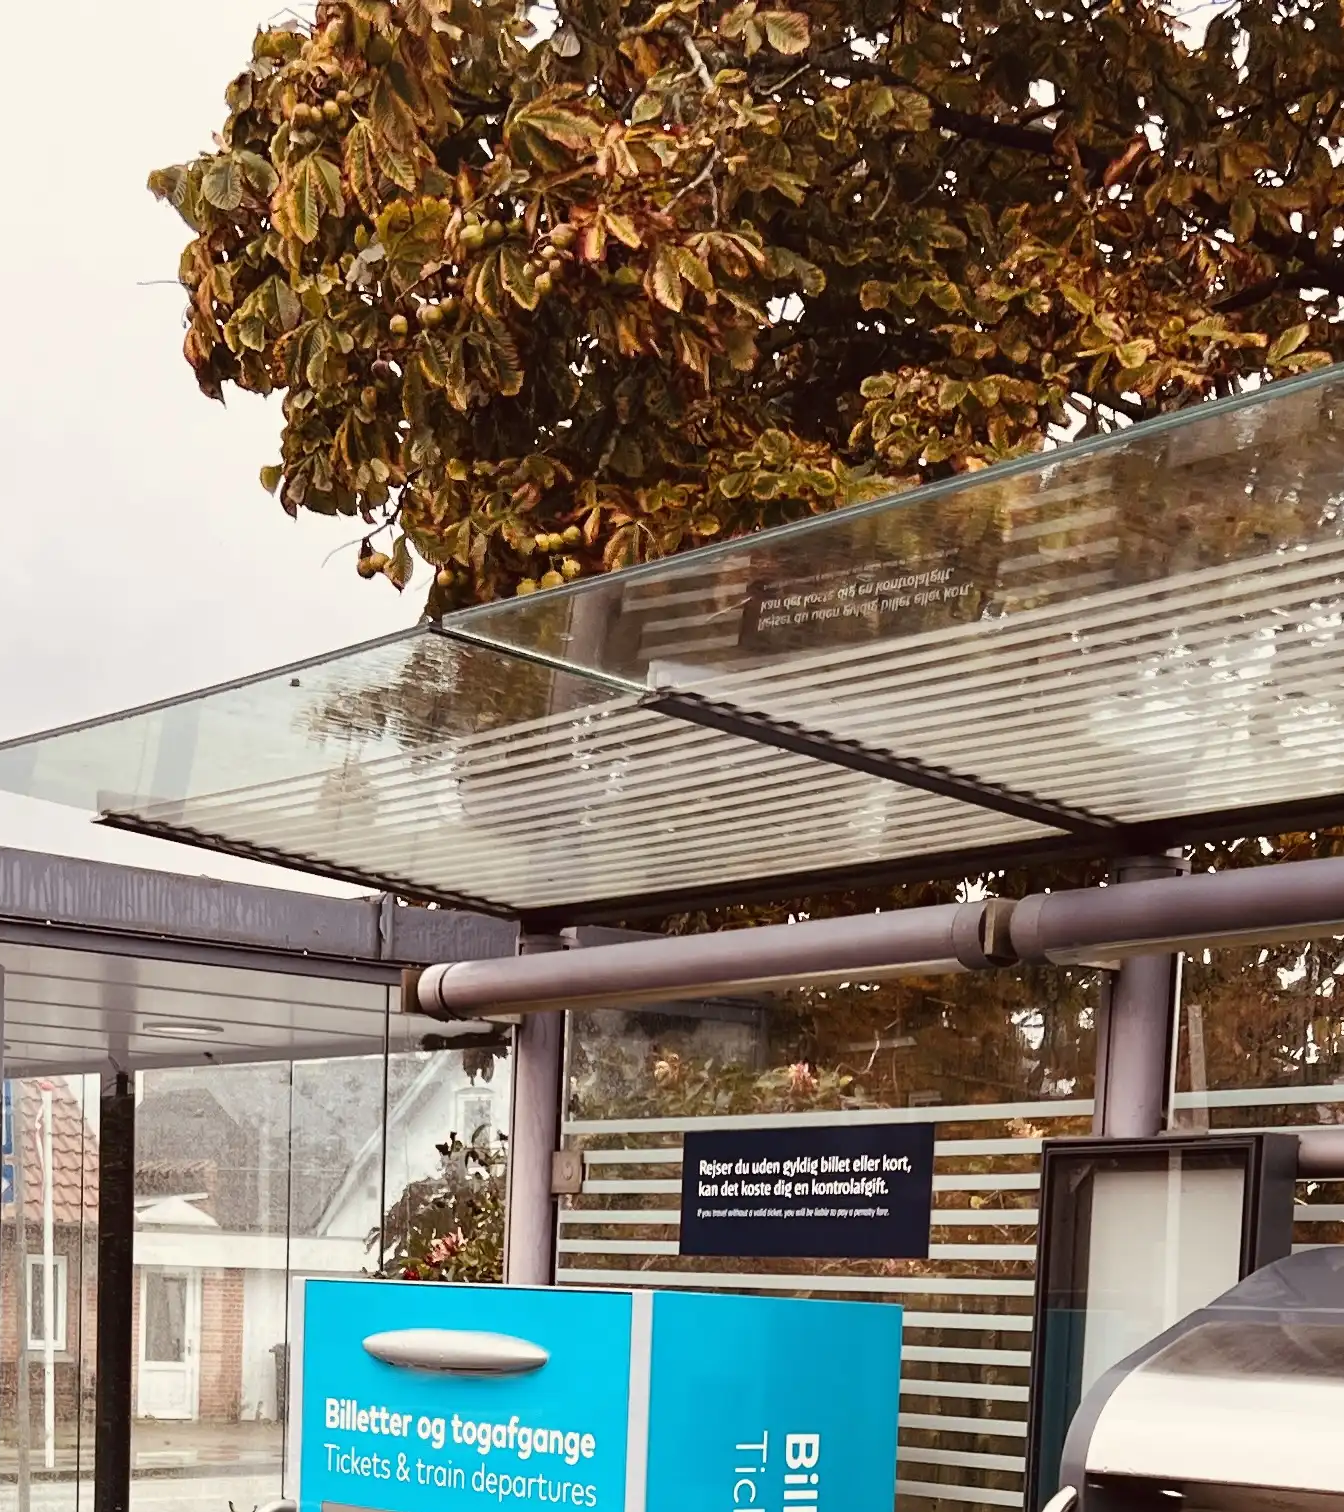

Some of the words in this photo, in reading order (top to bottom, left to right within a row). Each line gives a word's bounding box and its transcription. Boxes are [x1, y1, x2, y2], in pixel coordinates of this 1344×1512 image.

[699, 1159, 733, 1179] Rejser
[735, 1158, 749, 1175] du
[752, 1157, 780, 1175] uden
[782, 1156, 818, 1177] gyldig
[821, 1155, 850, 1172] billet
[853, 1154, 880, 1172] eller
[883, 1154, 912, 1174] kort,
[698, 1180, 718, 1197] kan
[720, 1180, 739, 1196] det
[741, 1180, 771, 1196] koste
[774, 1179, 792, 1198] dig
[794, 1182, 809, 1196] en
[811, 1177, 889, 1197] kontrolafgift.
[702, 1209, 711, 1219] you
[784, 1209, 794, 1219] you
[325, 1397, 412, 1437] Billetter
[417, 1416, 445, 1449] og
[451, 1413, 596, 1465] togafgange
[323, 1443, 391, 1480] Tickets
[396, 1452, 411, 1482] &
[416, 1458, 465, 1490] train
[471, 1462, 597, 1507] departures
